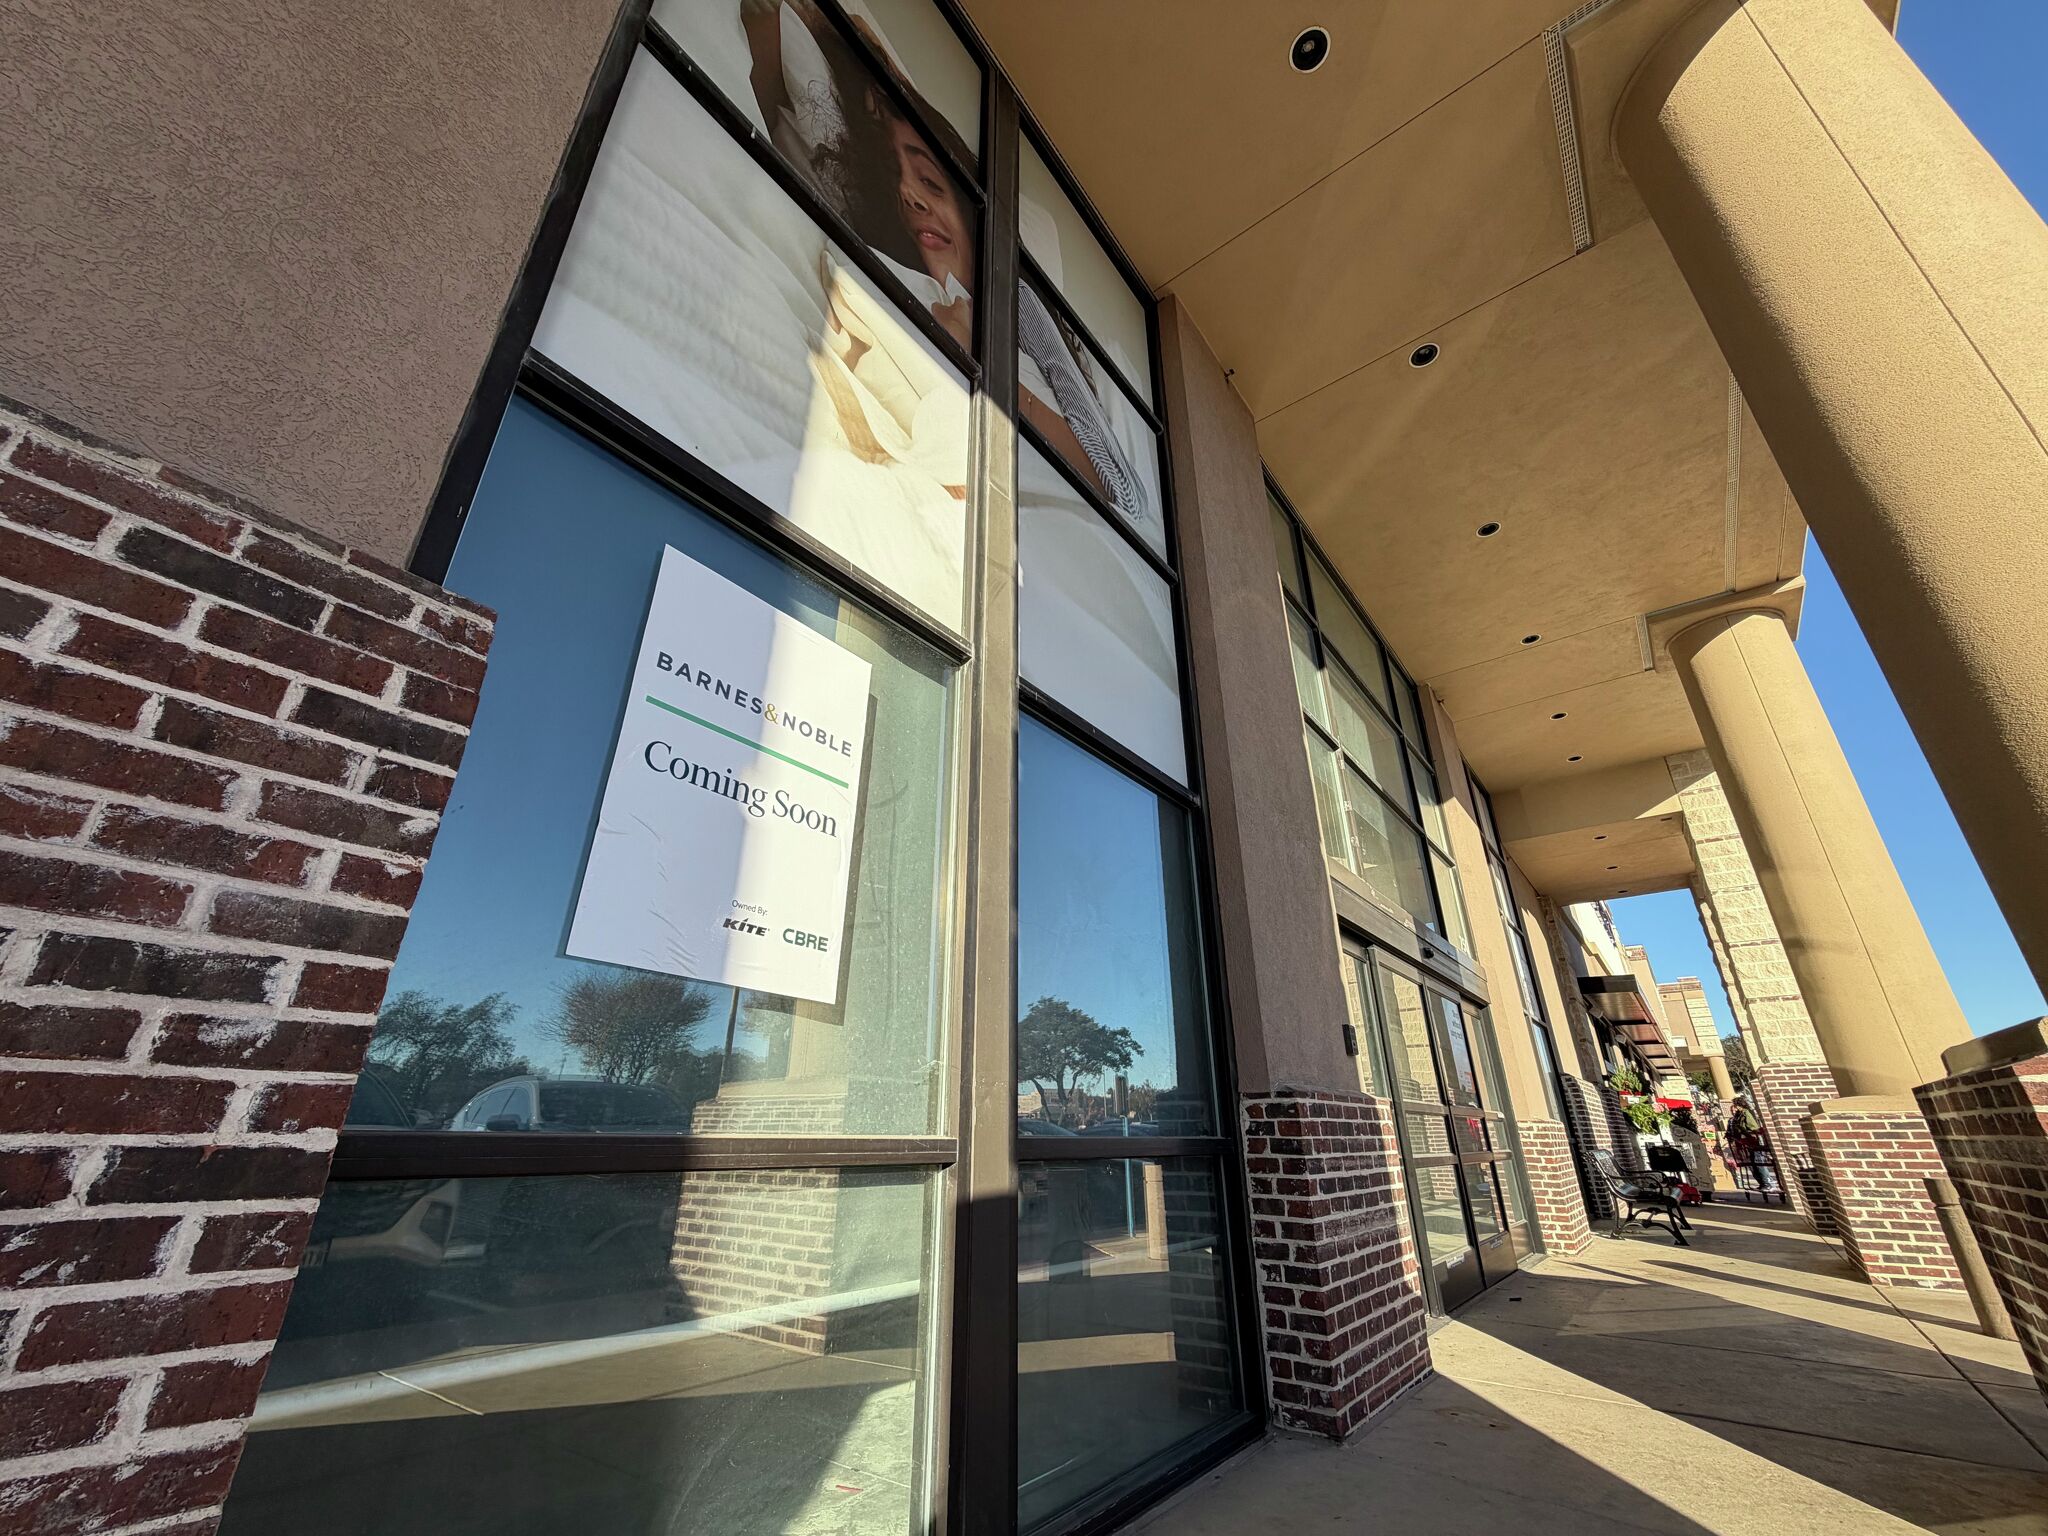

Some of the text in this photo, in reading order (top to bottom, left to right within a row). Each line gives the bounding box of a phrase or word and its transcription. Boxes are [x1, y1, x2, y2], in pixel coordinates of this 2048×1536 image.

[644, 740, 837, 837] Coming Soon
[731, 899, 768, 917] Owned By:
[782, 928, 829, 952] CBRE
